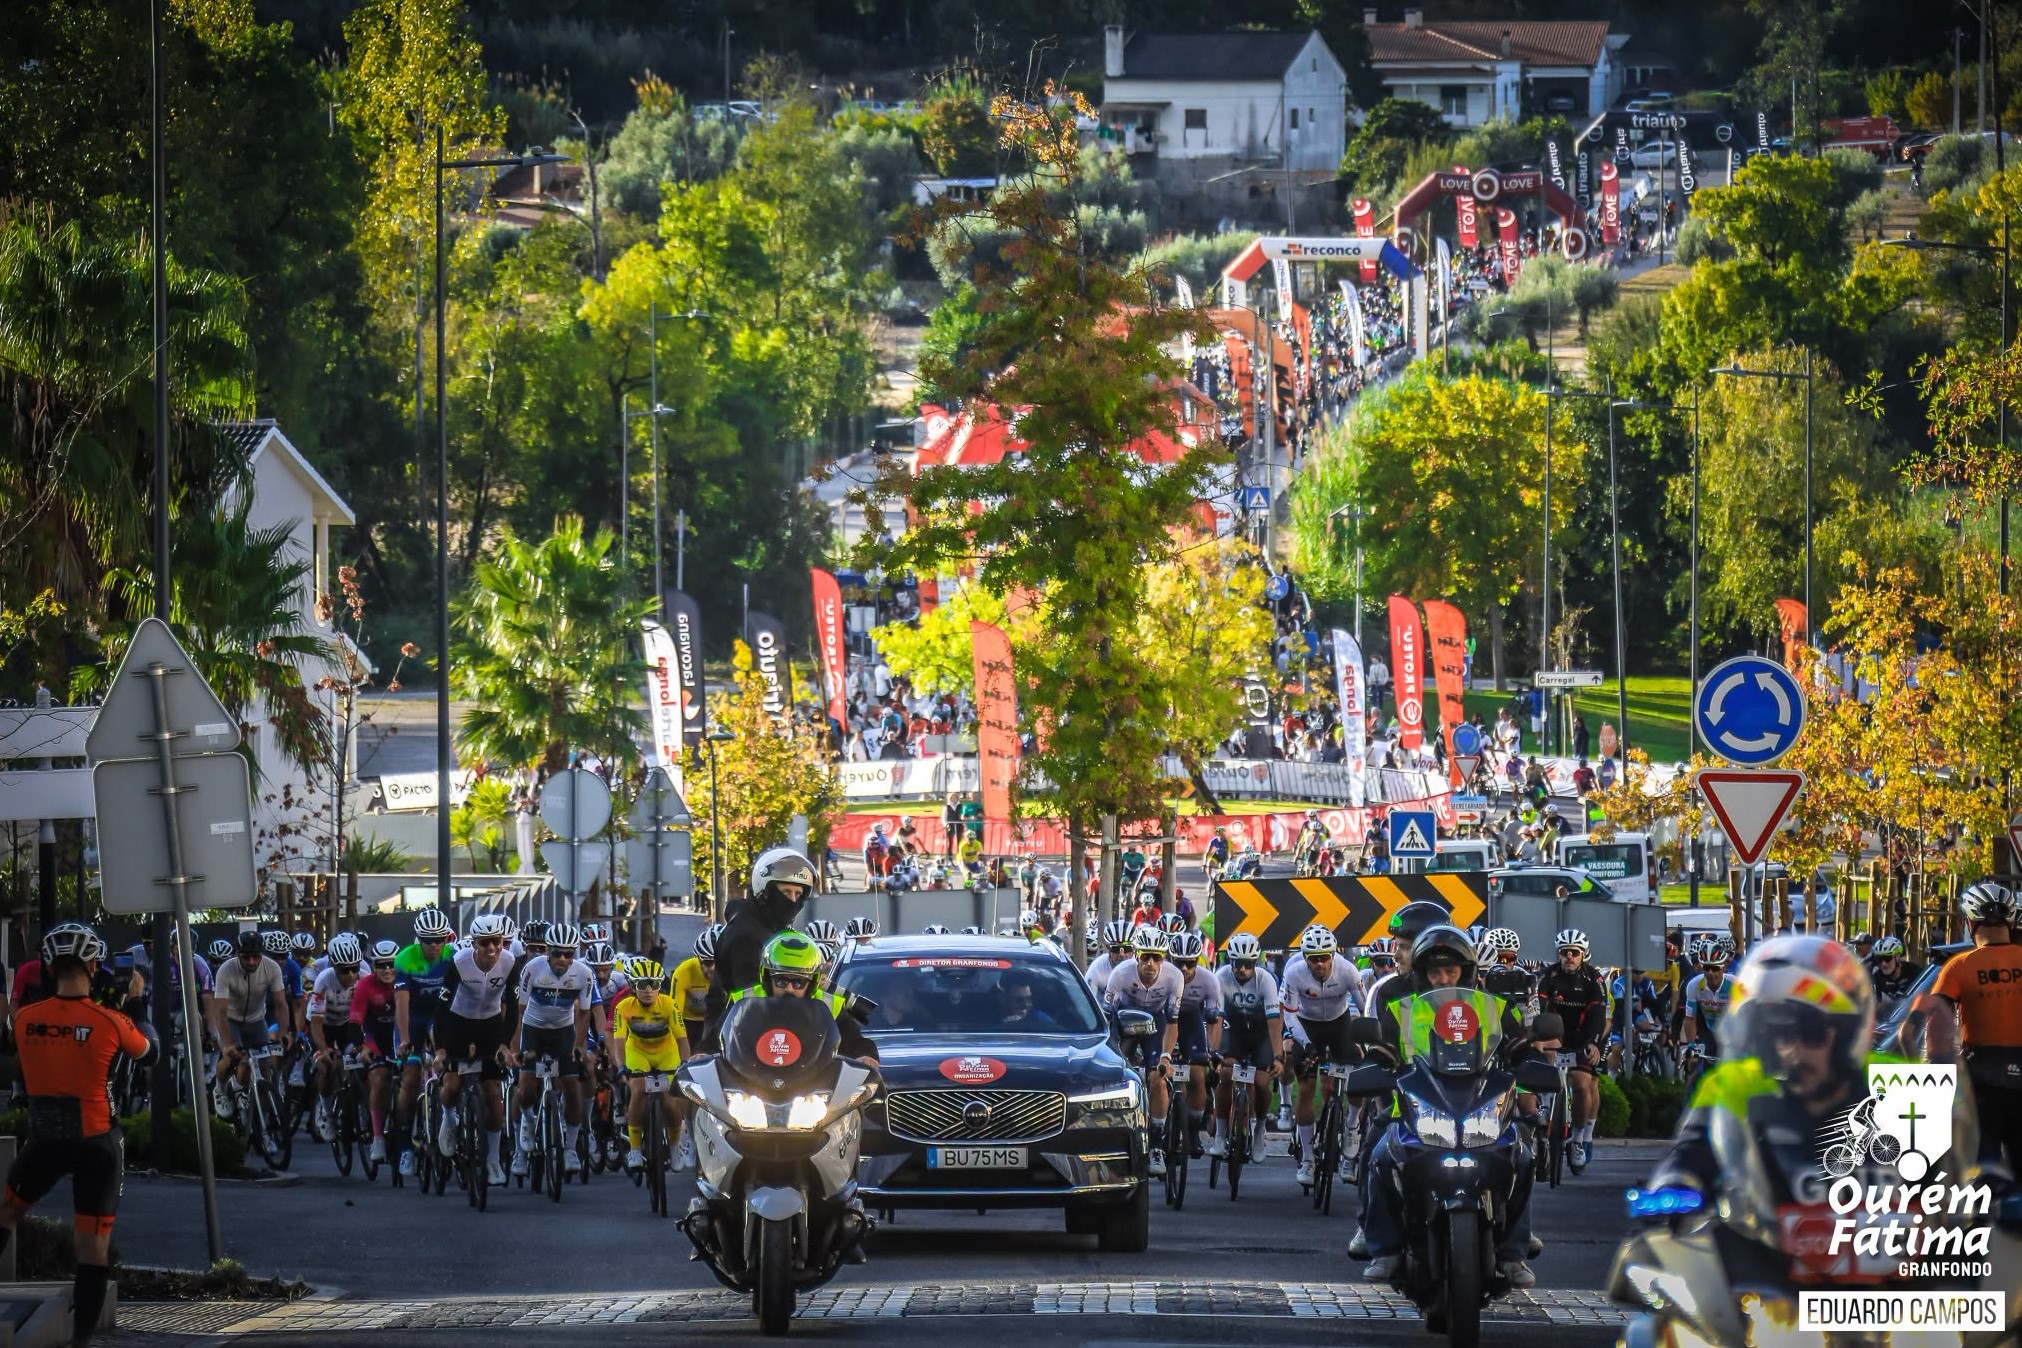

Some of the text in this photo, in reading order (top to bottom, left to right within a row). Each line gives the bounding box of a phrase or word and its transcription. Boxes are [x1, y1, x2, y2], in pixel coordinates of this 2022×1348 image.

[1632, 114, 1686, 128] triauto
[1578, 152, 1588, 193] triauto
[1440, 178, 1470, 189] LOVE
[1503, 178, 1533, 189] LOVE
[1303, 244, 1362, 256] reconco
[1540, 676, 1575, 685] Carregal
[1451, 802, 1487, 811] SECRETARIADO
[1587, 861, 1627, 871] VASSOURA
[1454, 1032, 1463, 1041] 3
[774, 1056, 784, 1065] 4
